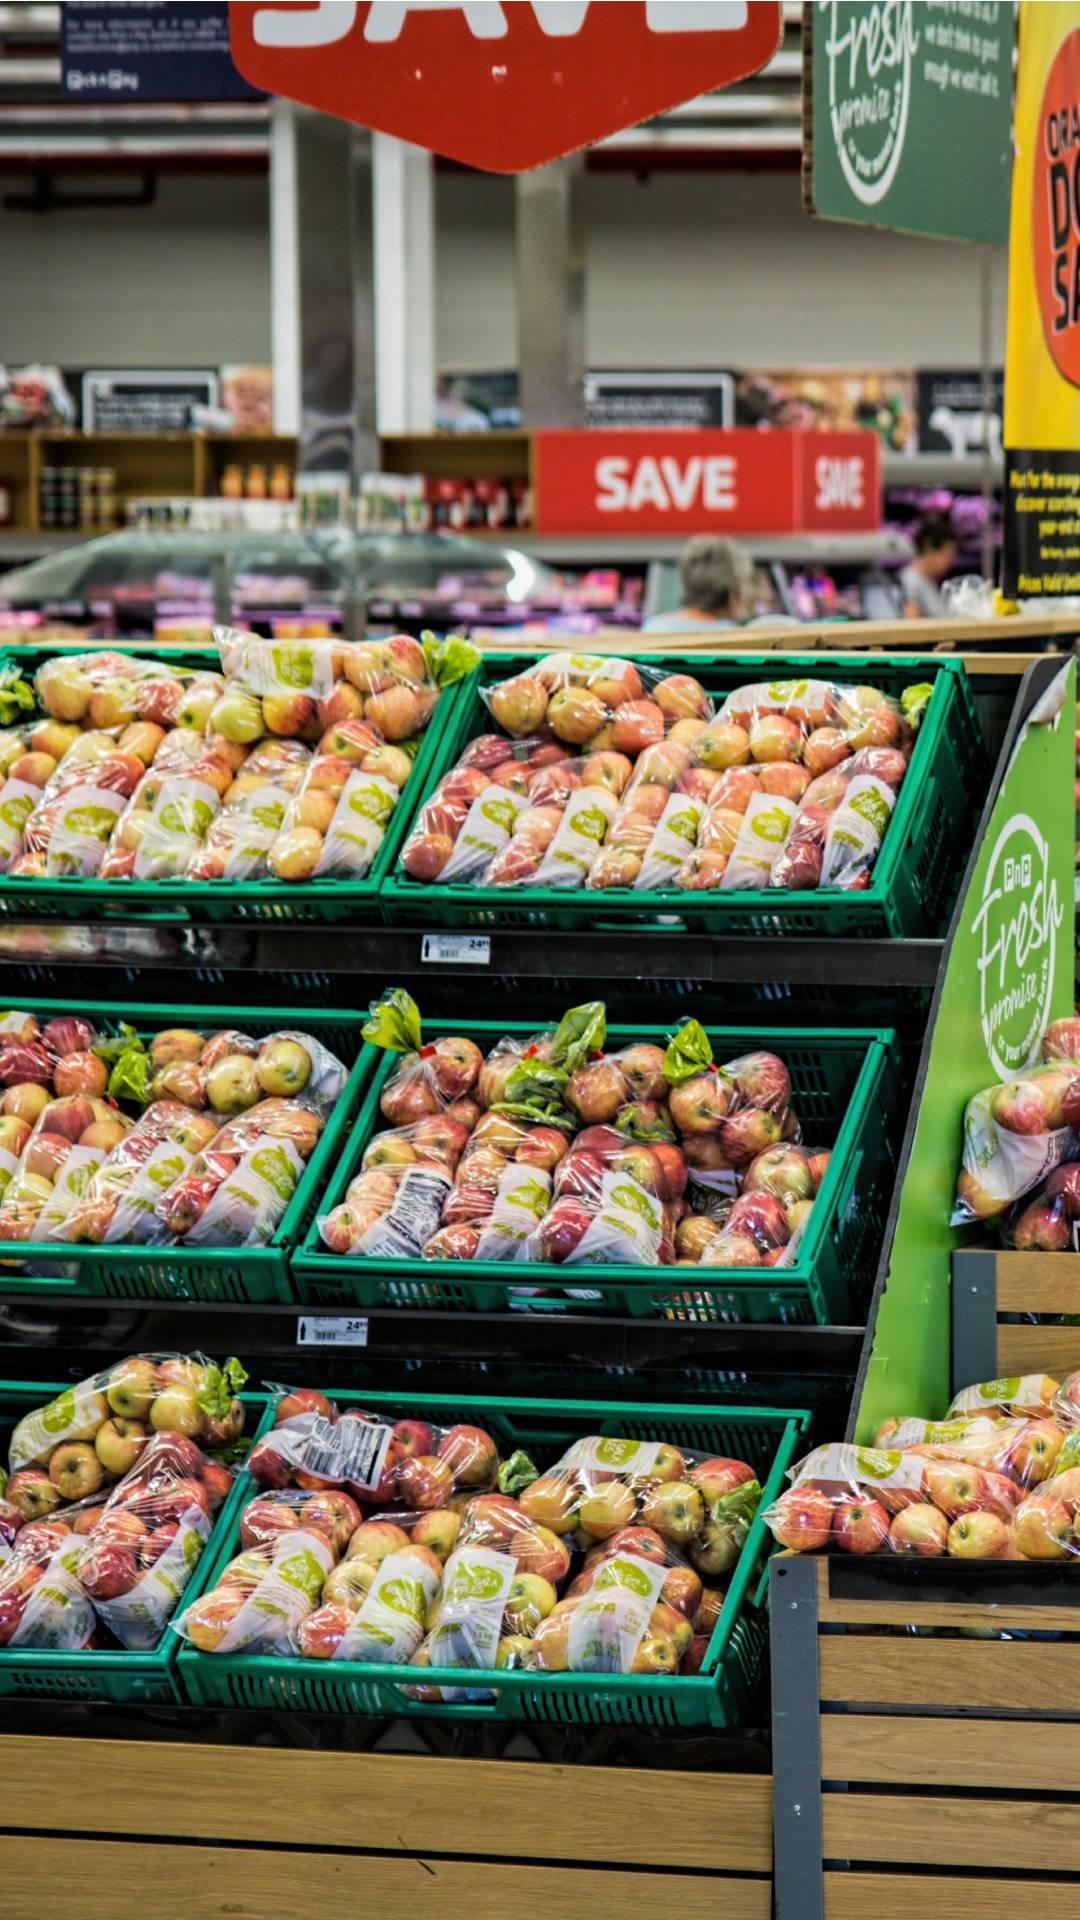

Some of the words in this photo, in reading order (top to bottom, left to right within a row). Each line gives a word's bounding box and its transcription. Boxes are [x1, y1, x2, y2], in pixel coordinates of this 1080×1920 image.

[594, 456, 737, 511] SAVE
[815, 456, 865, 510] SAVE
[1003, 854, 1031, 892] PnP
[971, 841, 1065, 989] Fresh
